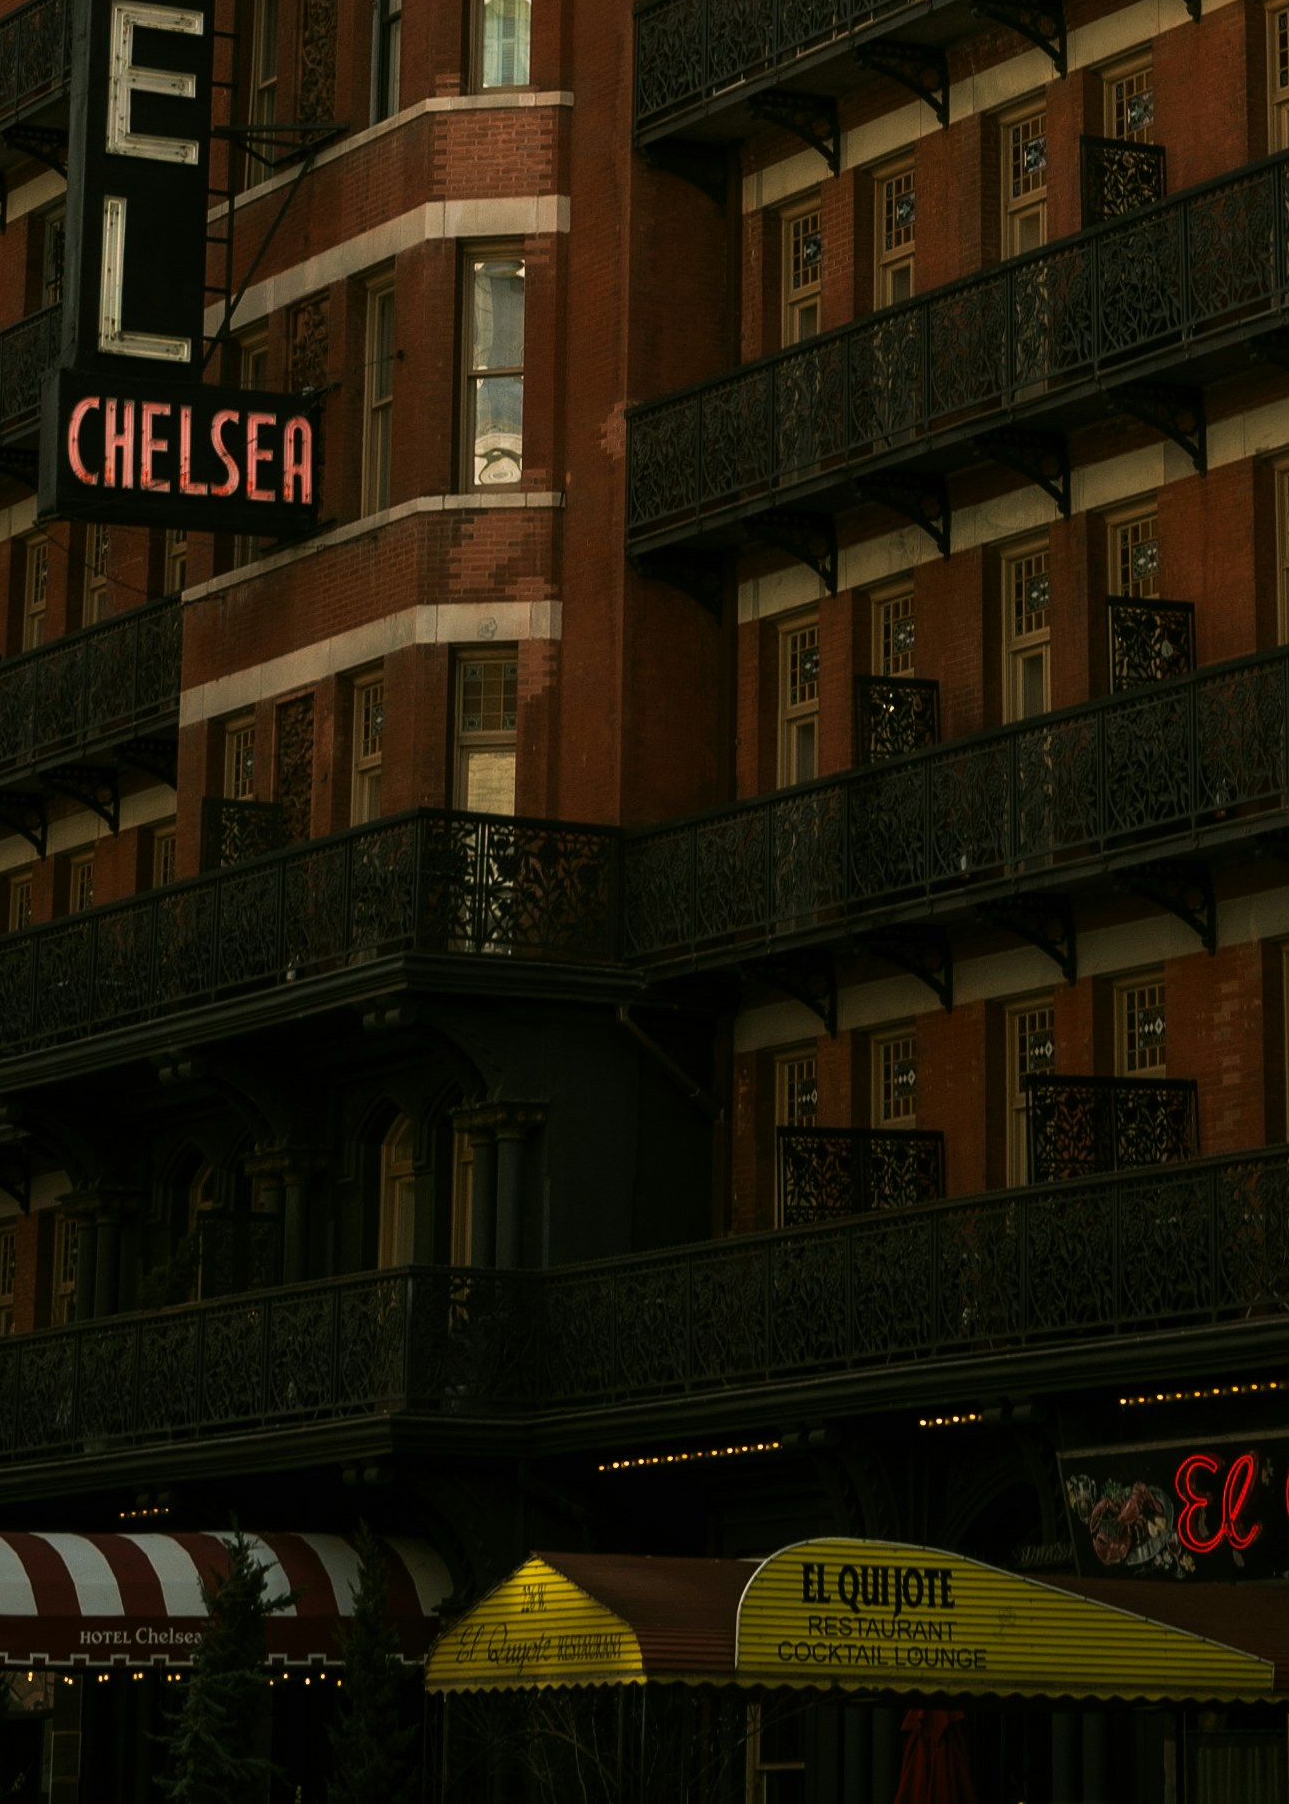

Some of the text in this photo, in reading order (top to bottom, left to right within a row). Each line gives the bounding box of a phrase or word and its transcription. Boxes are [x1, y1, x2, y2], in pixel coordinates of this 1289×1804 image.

[67, 395, 313, 505] CHELSEA
[1174, 1453, 1260, 1553] El
[802, 1562, 956, 1618] EL QUIJOTE
[80, 1626, 203, 1645] HOTEL Chelsea
[456, 1622, 485, 1664] El
[558, 1631, 622, 1661] RESTAURANT
[808, 1616, 958, 1641] RESTAURANT
[778, 1640, 987, 1670] COCKTAIL LOUNGE
